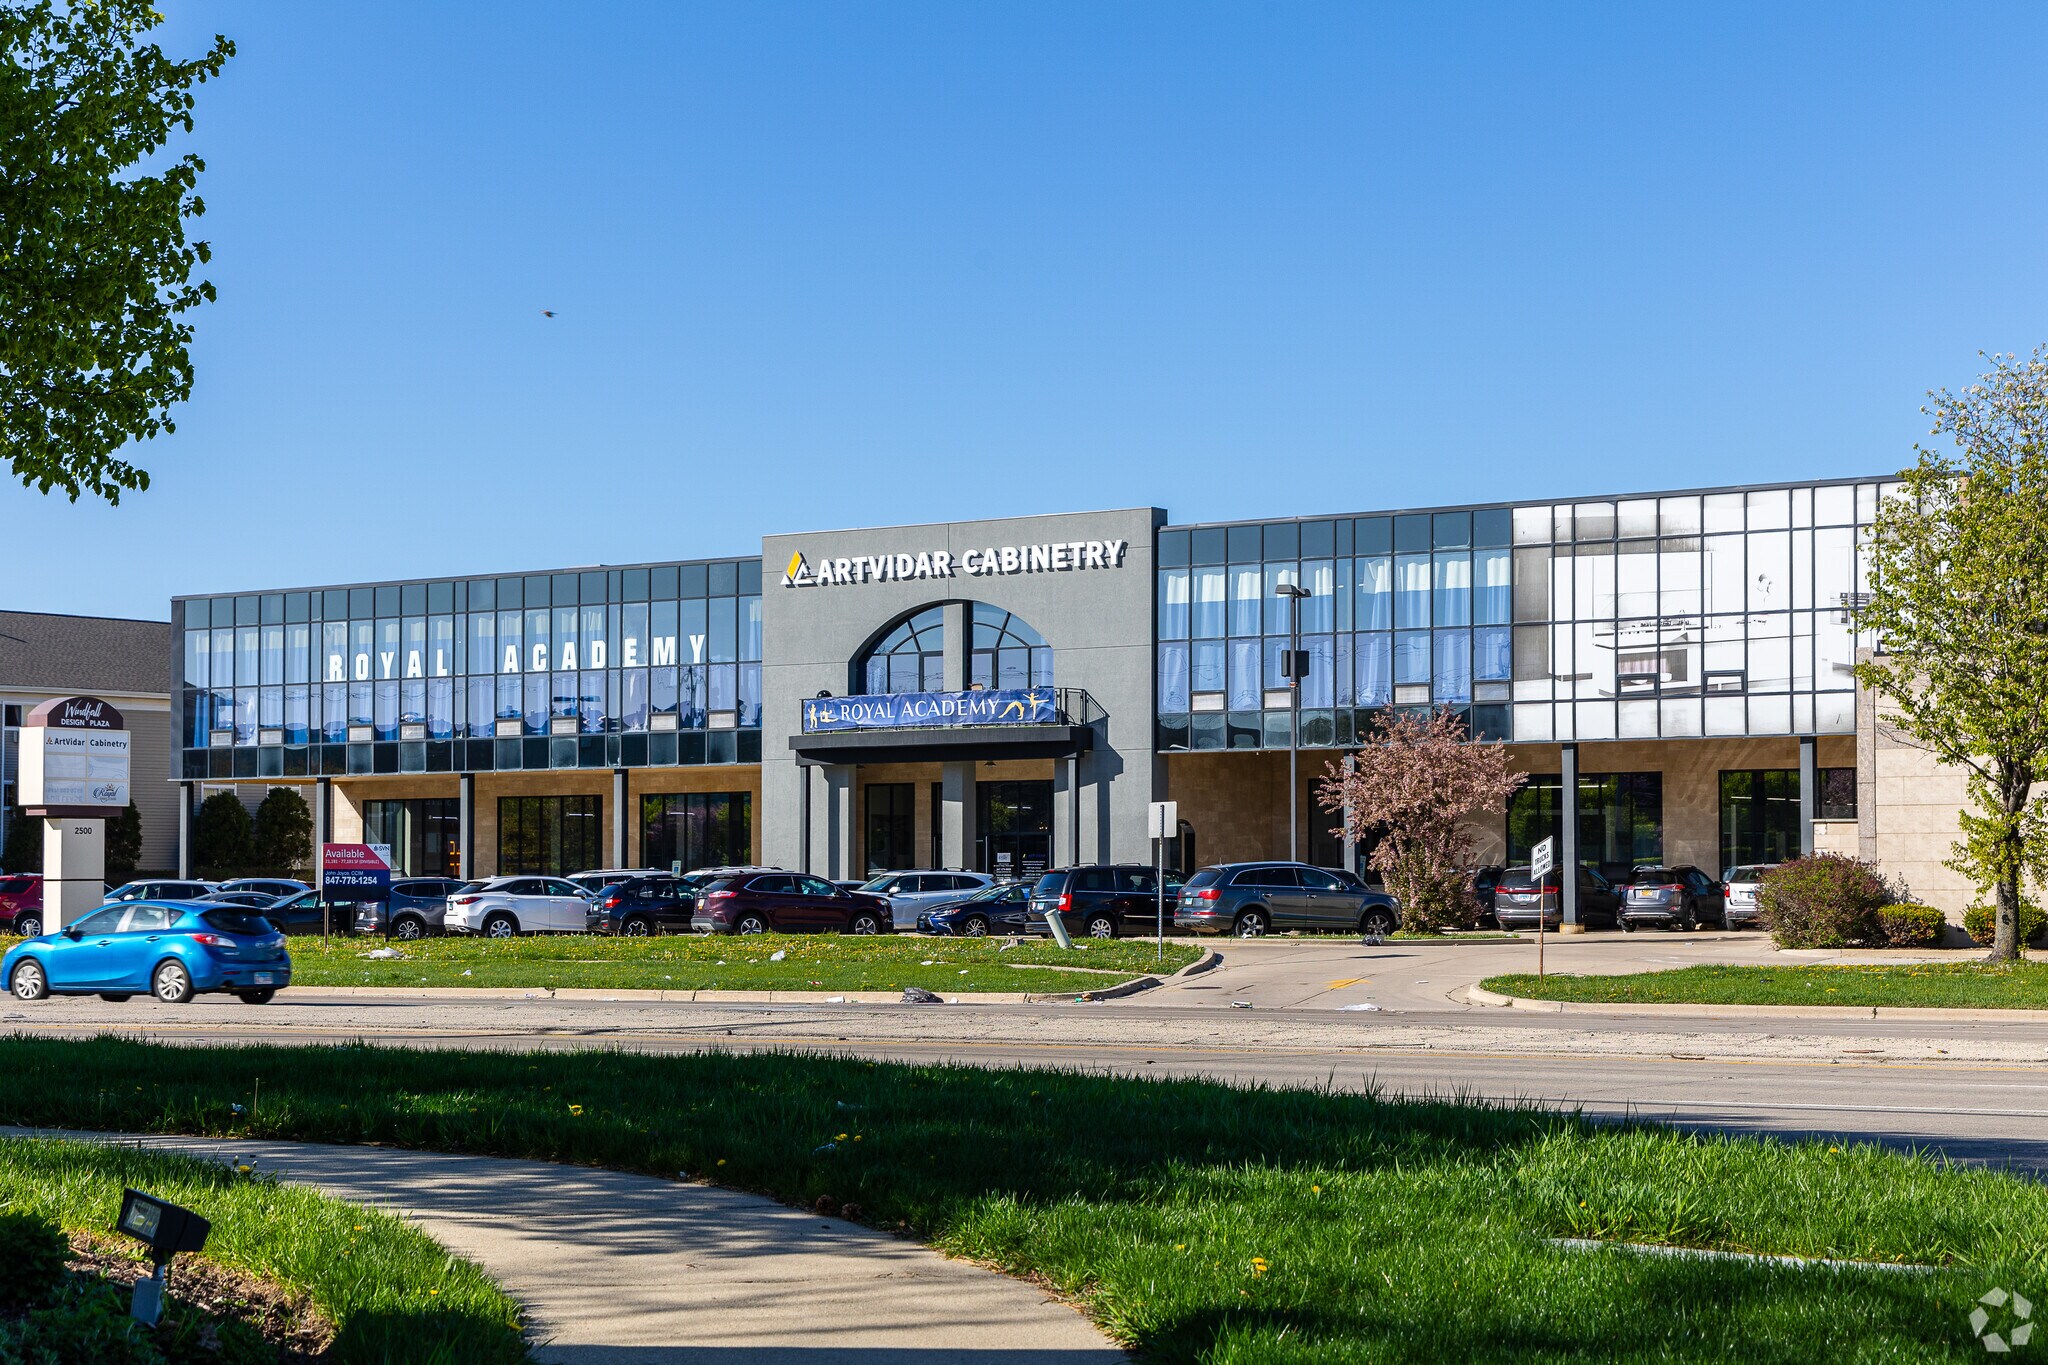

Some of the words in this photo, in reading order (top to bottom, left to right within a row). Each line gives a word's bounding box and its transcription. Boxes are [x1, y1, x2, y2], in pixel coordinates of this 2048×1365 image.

[816, 550, 950, 583] ARTVIDAR
[962, 539, 1124, 574] CABINETRY
[329, 649, 448, 682] ROYAL
[503, 634, 706, 673] ACADEMY
[65, 700, 102, 720] Windfall
[841, 702, 895, 720] ROYAL
[901, 698, 1000, 718] ACADEMY
[61, 718, 85, 726] DESIGN
[89, 720, 110, 728] PLAZA
[54, 738, 85, 746] ArtVidar
[90, 739, 127, 750] Cabinetry
[74, 826, 92, 835] 2500
[325, 849, 365, 858] Available
[1538, 844, 1546, 854] NO
[1535, 851, 1549, 865] TRUCKS
[1534, 860, 1550, 874] ALLOWED
[325, 876, 377, 885] 847-778-1254
